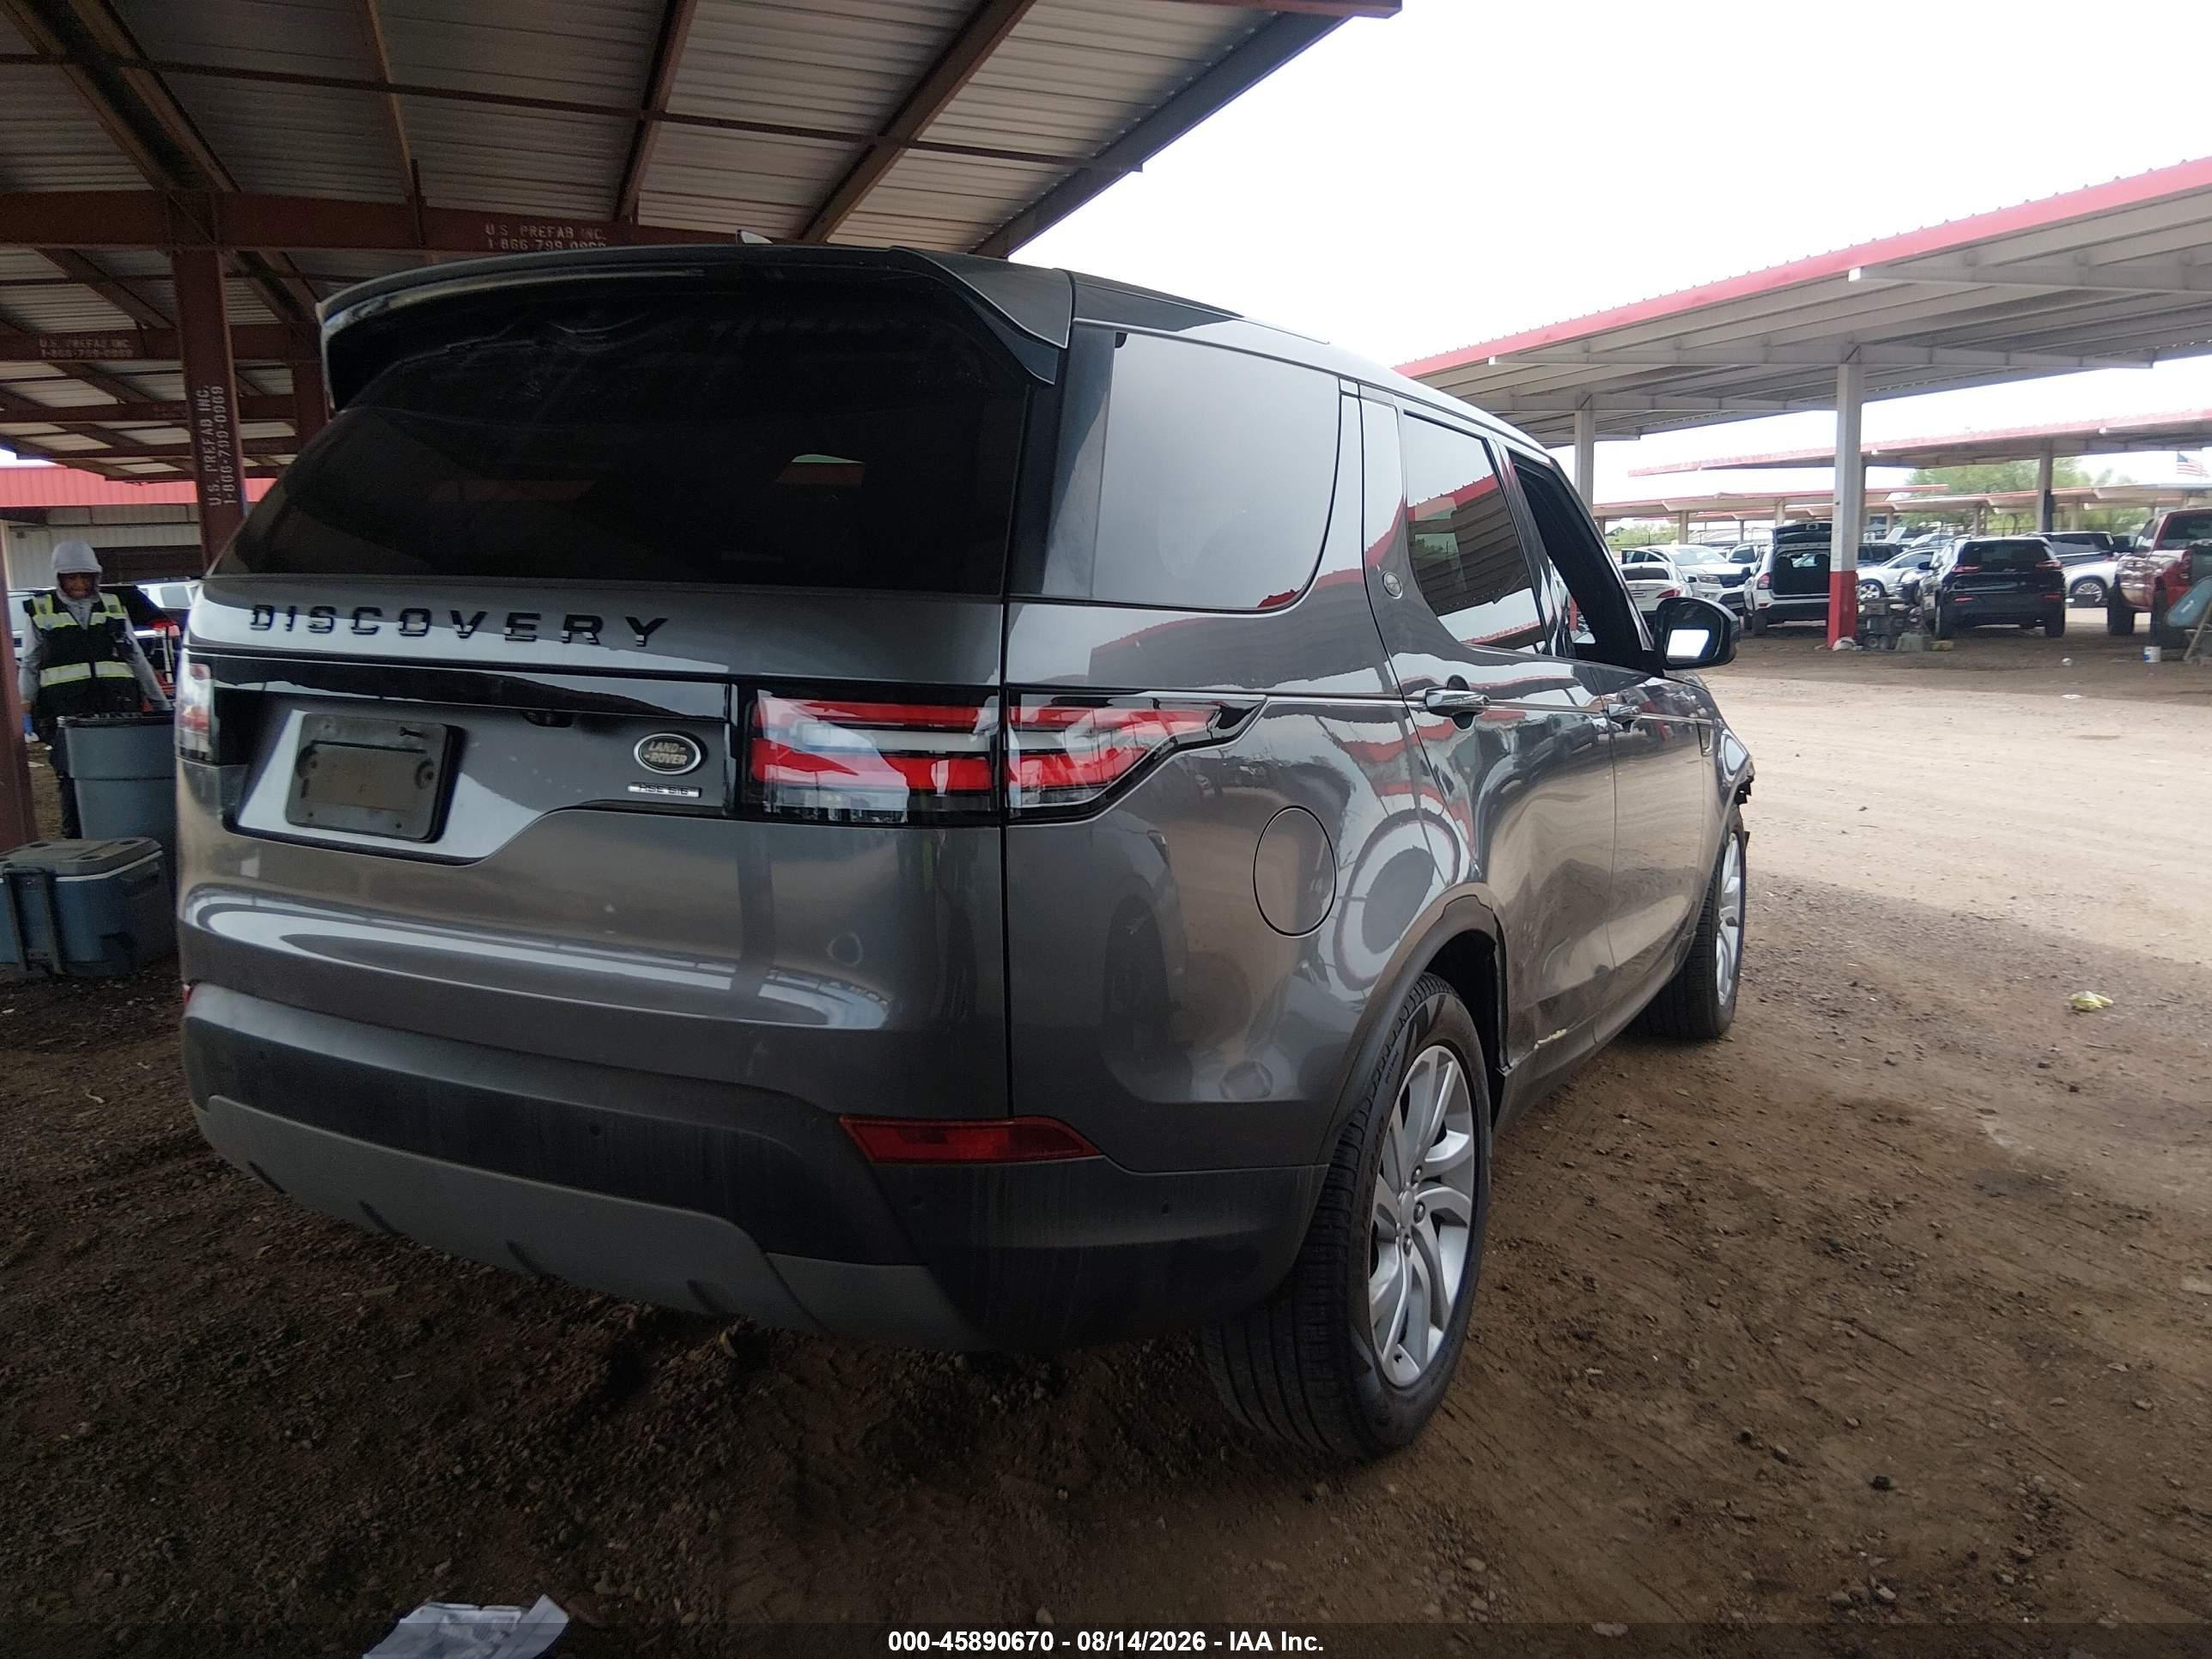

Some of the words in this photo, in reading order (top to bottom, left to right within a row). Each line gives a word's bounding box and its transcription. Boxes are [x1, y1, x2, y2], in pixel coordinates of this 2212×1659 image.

[520, 225, 574, 239] PREFAB
[199, 418, 219, 472] PREFAB
[248, 603, 669, 647] DISCOVERY
